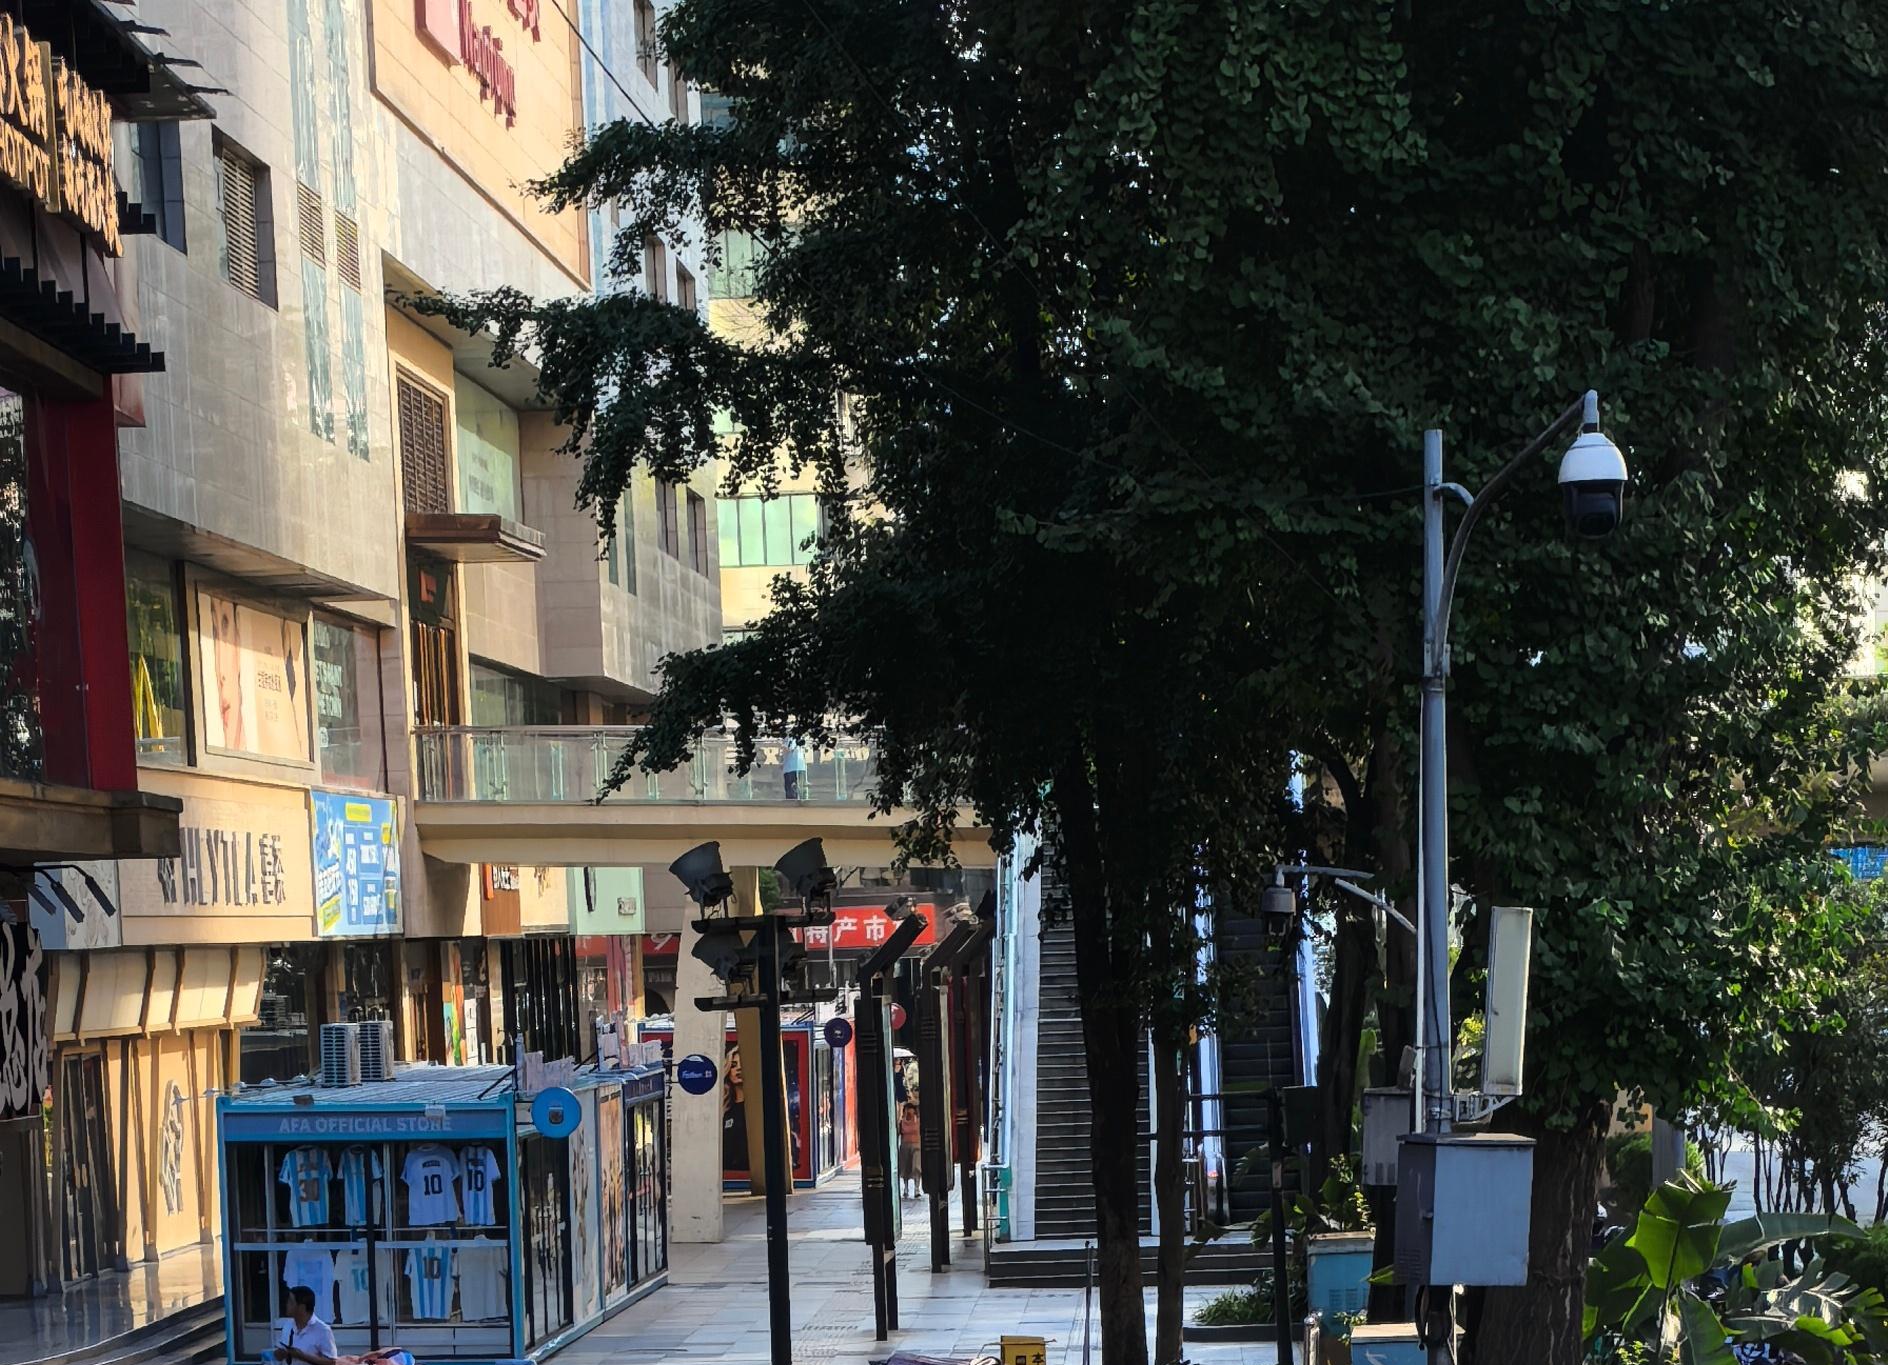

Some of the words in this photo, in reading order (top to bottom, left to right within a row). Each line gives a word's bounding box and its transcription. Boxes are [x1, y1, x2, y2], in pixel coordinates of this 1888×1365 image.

[788, 914, 906, 945] 特产市
[279, 1119, 311, 1133] AFA
[316, 1117, 392, 1133] OFFICIAL
[397, 1116, 453, 1132] STORE
[424, 1174, 443, 1196] 10
[467, 1169, 484, 1192] 10
[424, 1256, 440, 1279] 10
